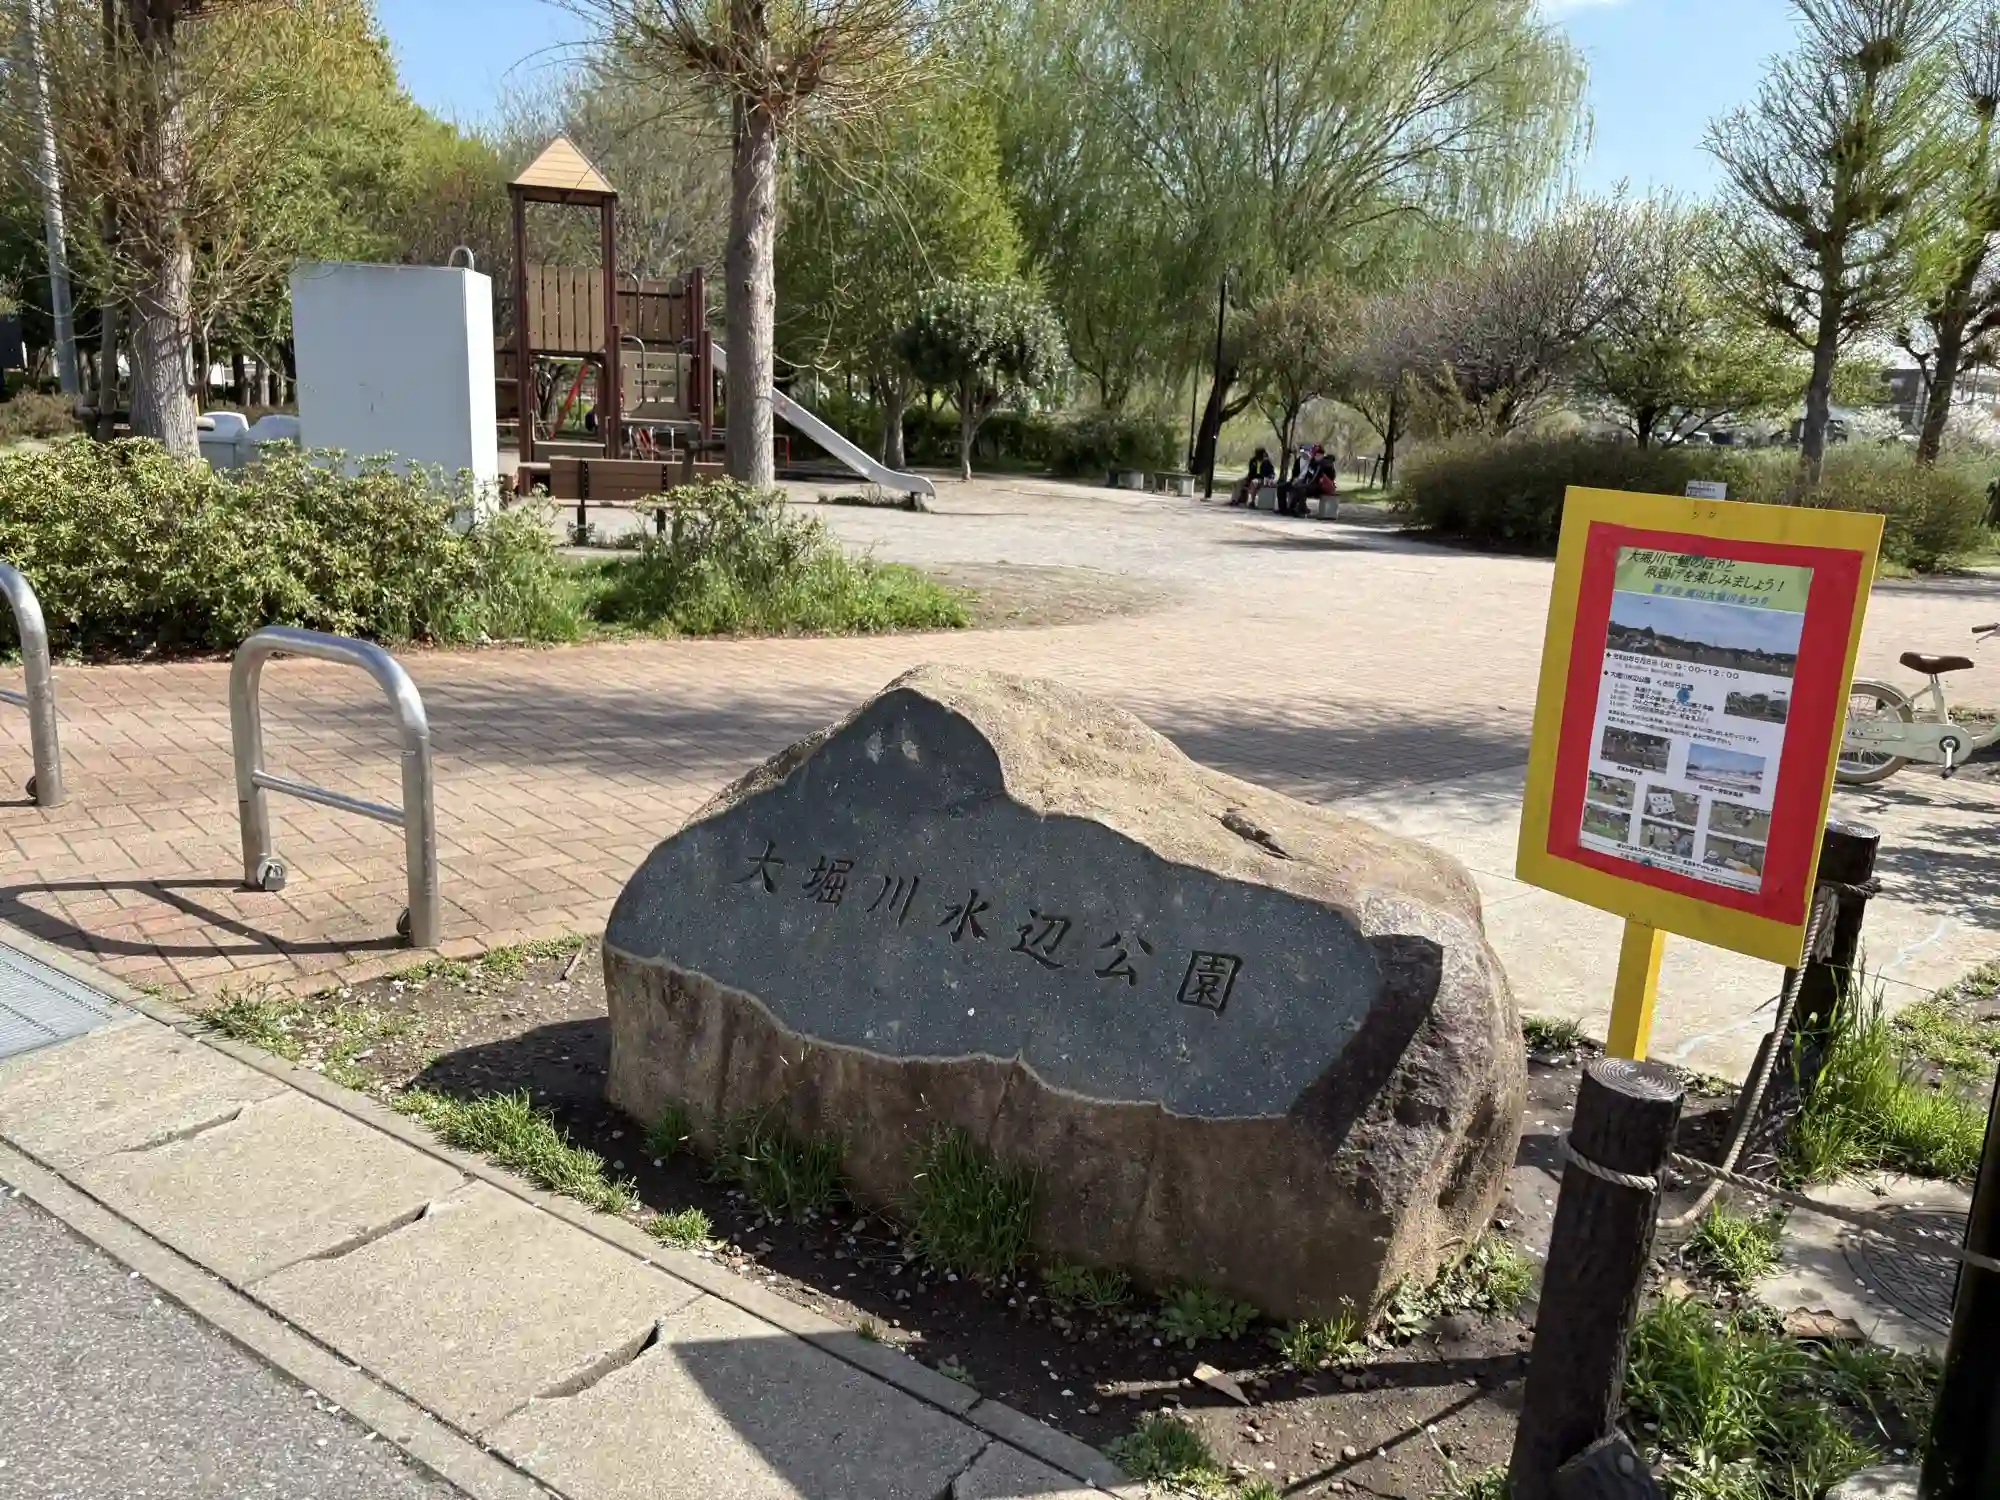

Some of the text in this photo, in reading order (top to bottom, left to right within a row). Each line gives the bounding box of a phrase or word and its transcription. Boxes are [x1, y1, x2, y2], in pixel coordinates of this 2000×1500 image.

[734, 838, 1242, 1018] 大堀川水辺公園
